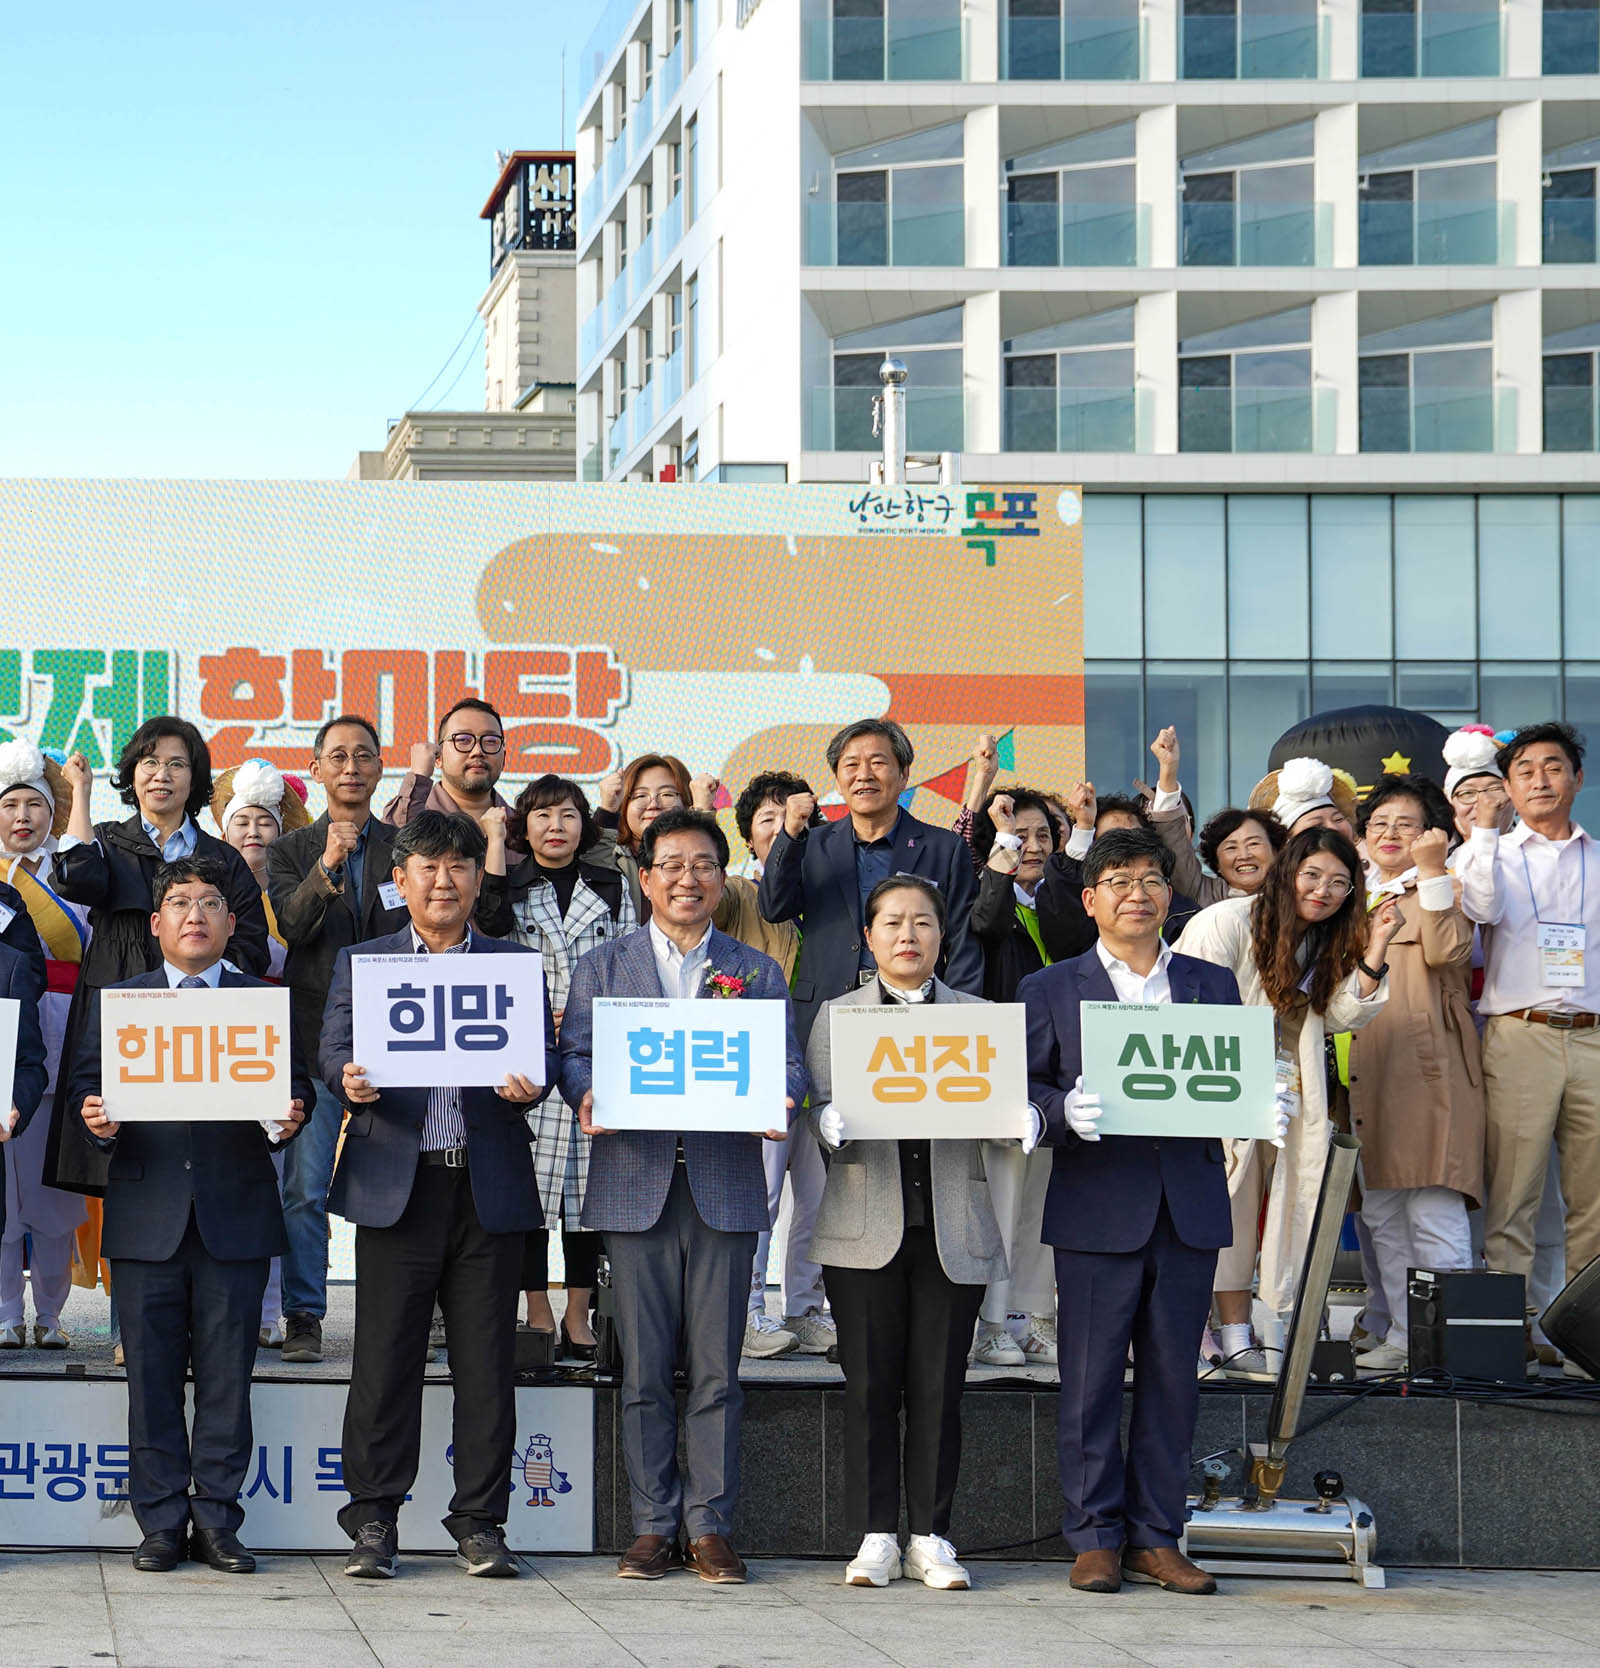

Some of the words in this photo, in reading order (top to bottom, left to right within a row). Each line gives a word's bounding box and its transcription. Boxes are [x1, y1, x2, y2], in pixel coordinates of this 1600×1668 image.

[199, 646, 621, 774] 한마당
[387, 982, 514, 1052] 희망
[116, 1024, 281, 1083] 한마당
[626, 1027, 750, 1096] 협력
[866, 1035, 997, 1104] 성장
[1116, 1033, 1242, 1103] 상생
